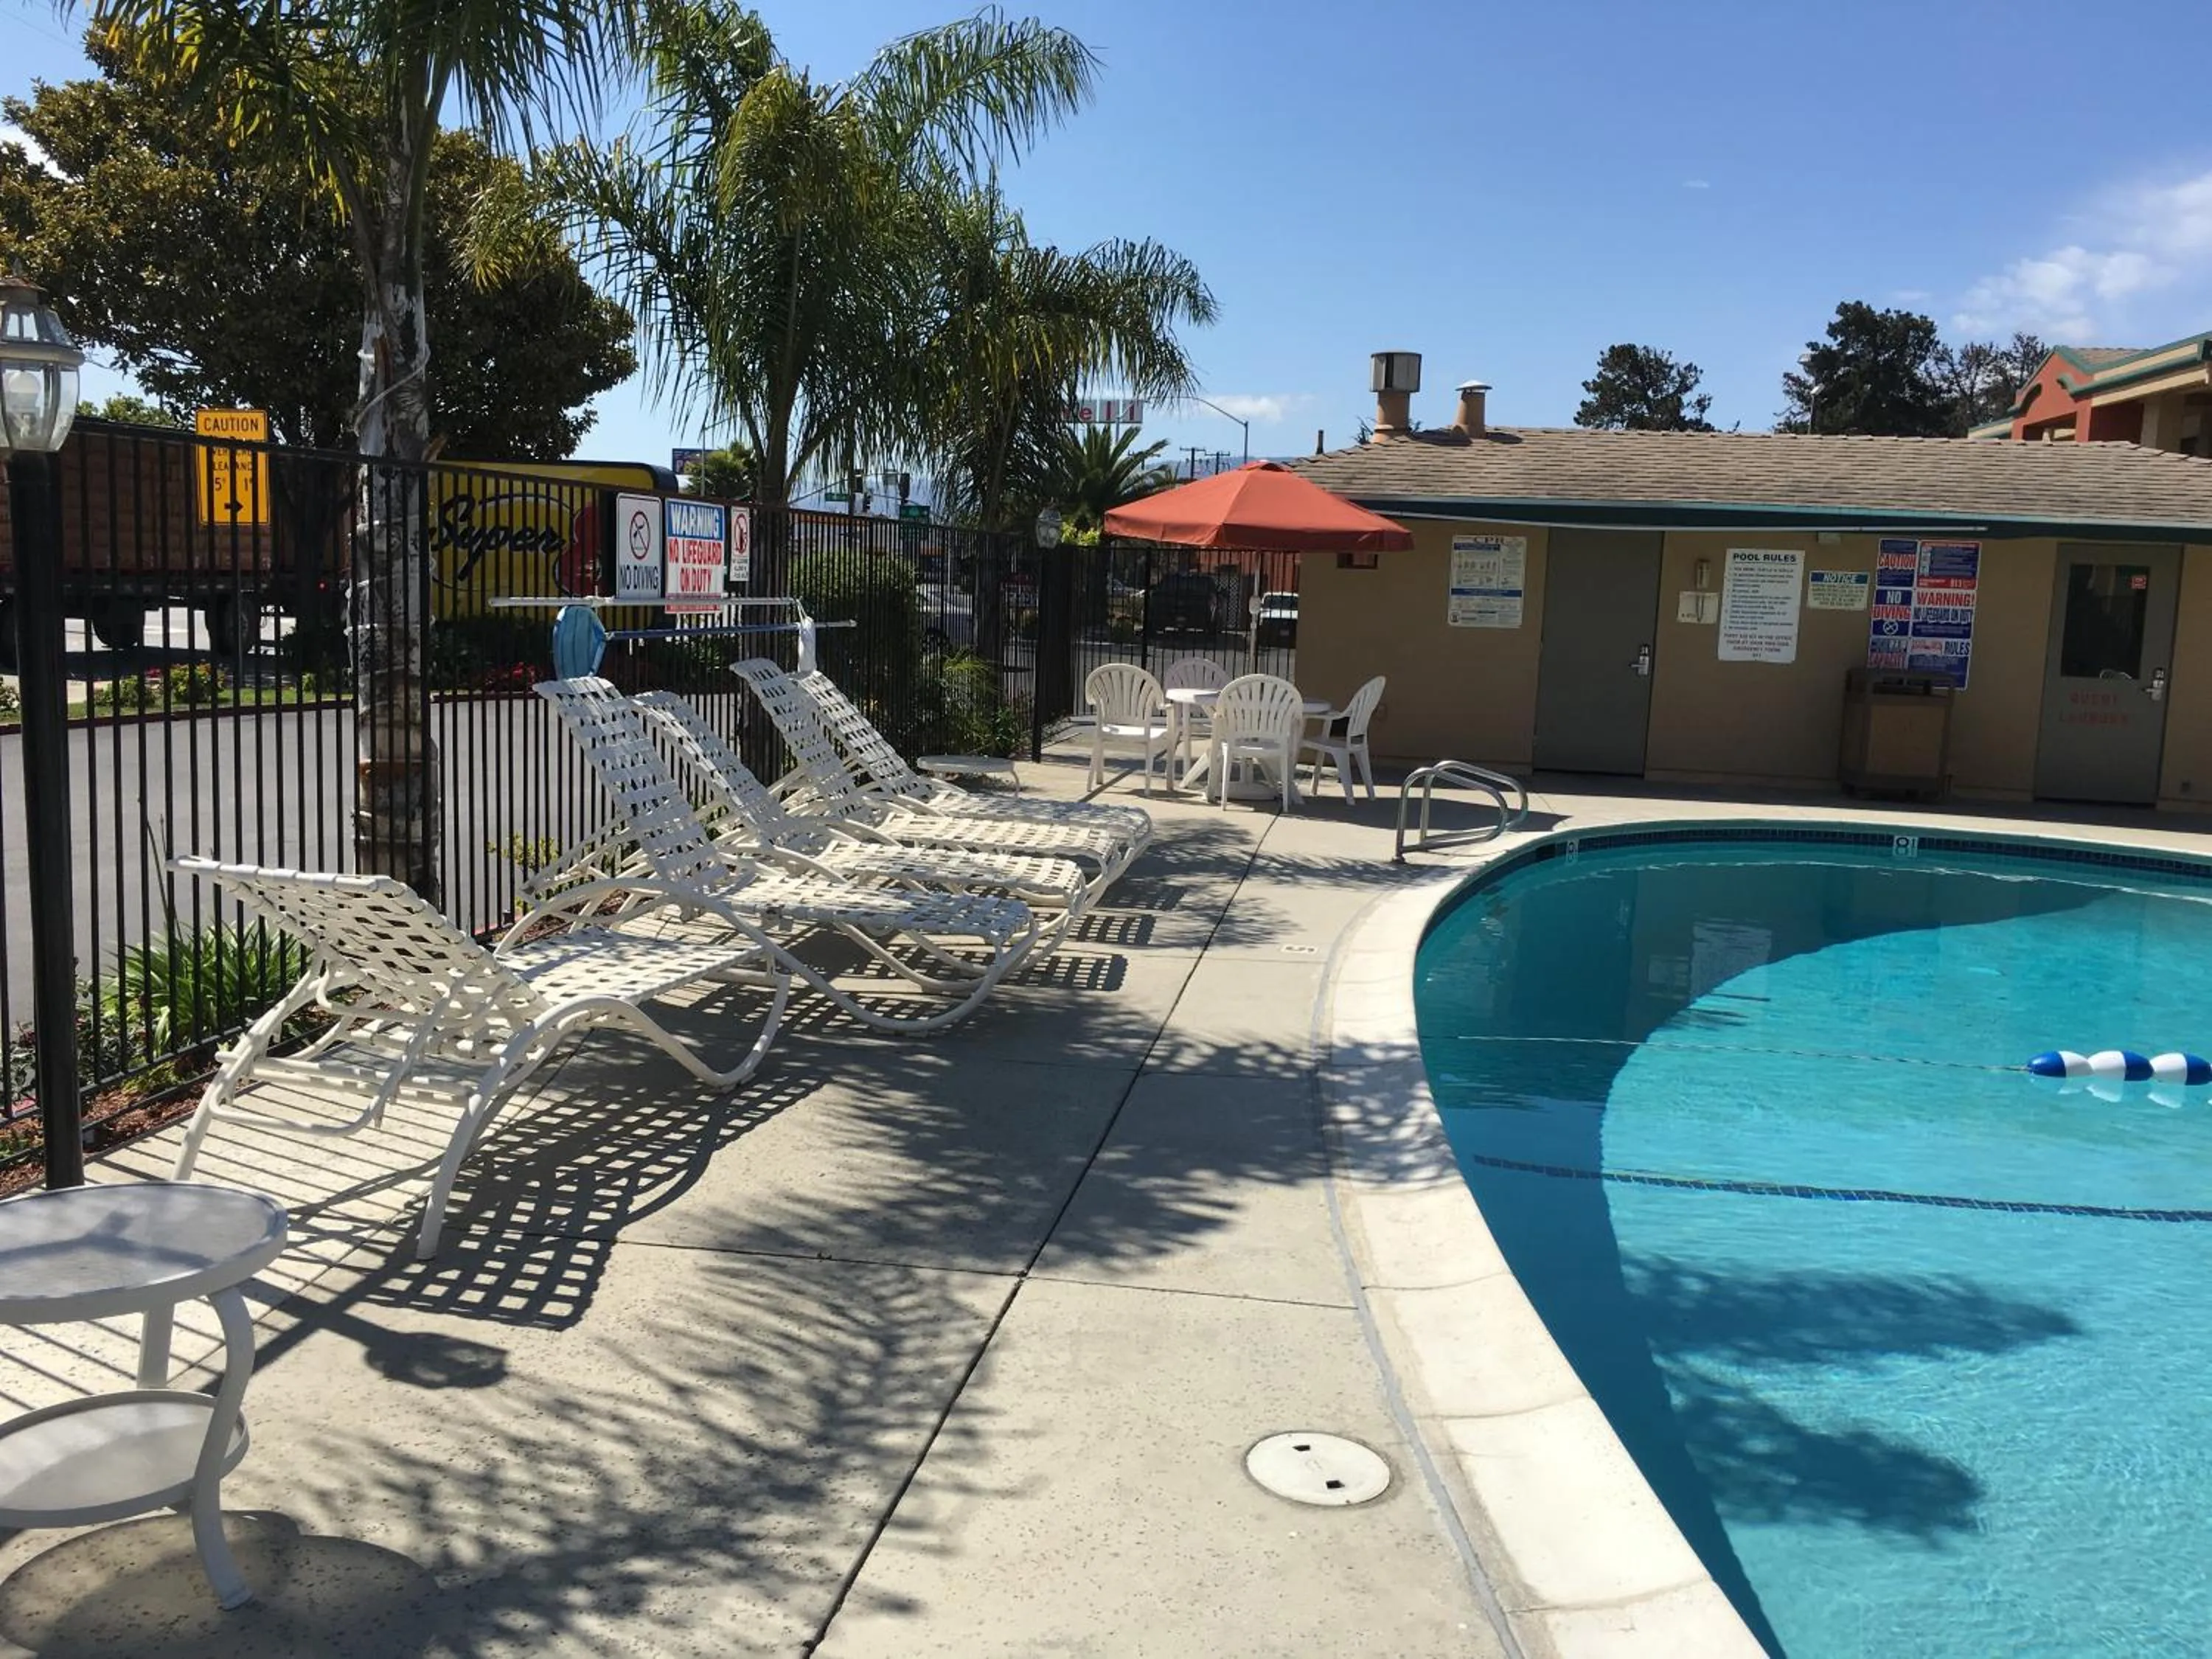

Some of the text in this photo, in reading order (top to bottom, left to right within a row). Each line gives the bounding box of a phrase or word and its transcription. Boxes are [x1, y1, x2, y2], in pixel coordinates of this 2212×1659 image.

[204, 417, 259, 432] CAUTION
[670, 504, 720, 538] WARNING
[669, 538, 722, 565] NO LIFEGUARD
[1733, 552, 1797, 563] POOL RULES
[1879, 553, 1916, 568] CAUTION
[620, 565, 659, 590] NO DIVING
[679, 567, 713, 592] ON DUTY
[1823, 571, 1858, 583] NOTICE
[1886, 591, 1902, 604] NO
[1917, 591, 1976, 606] WARNING!
[1871, 605, 1911, 620] DIVING
[1944, 640, 1970, 655] RULES
